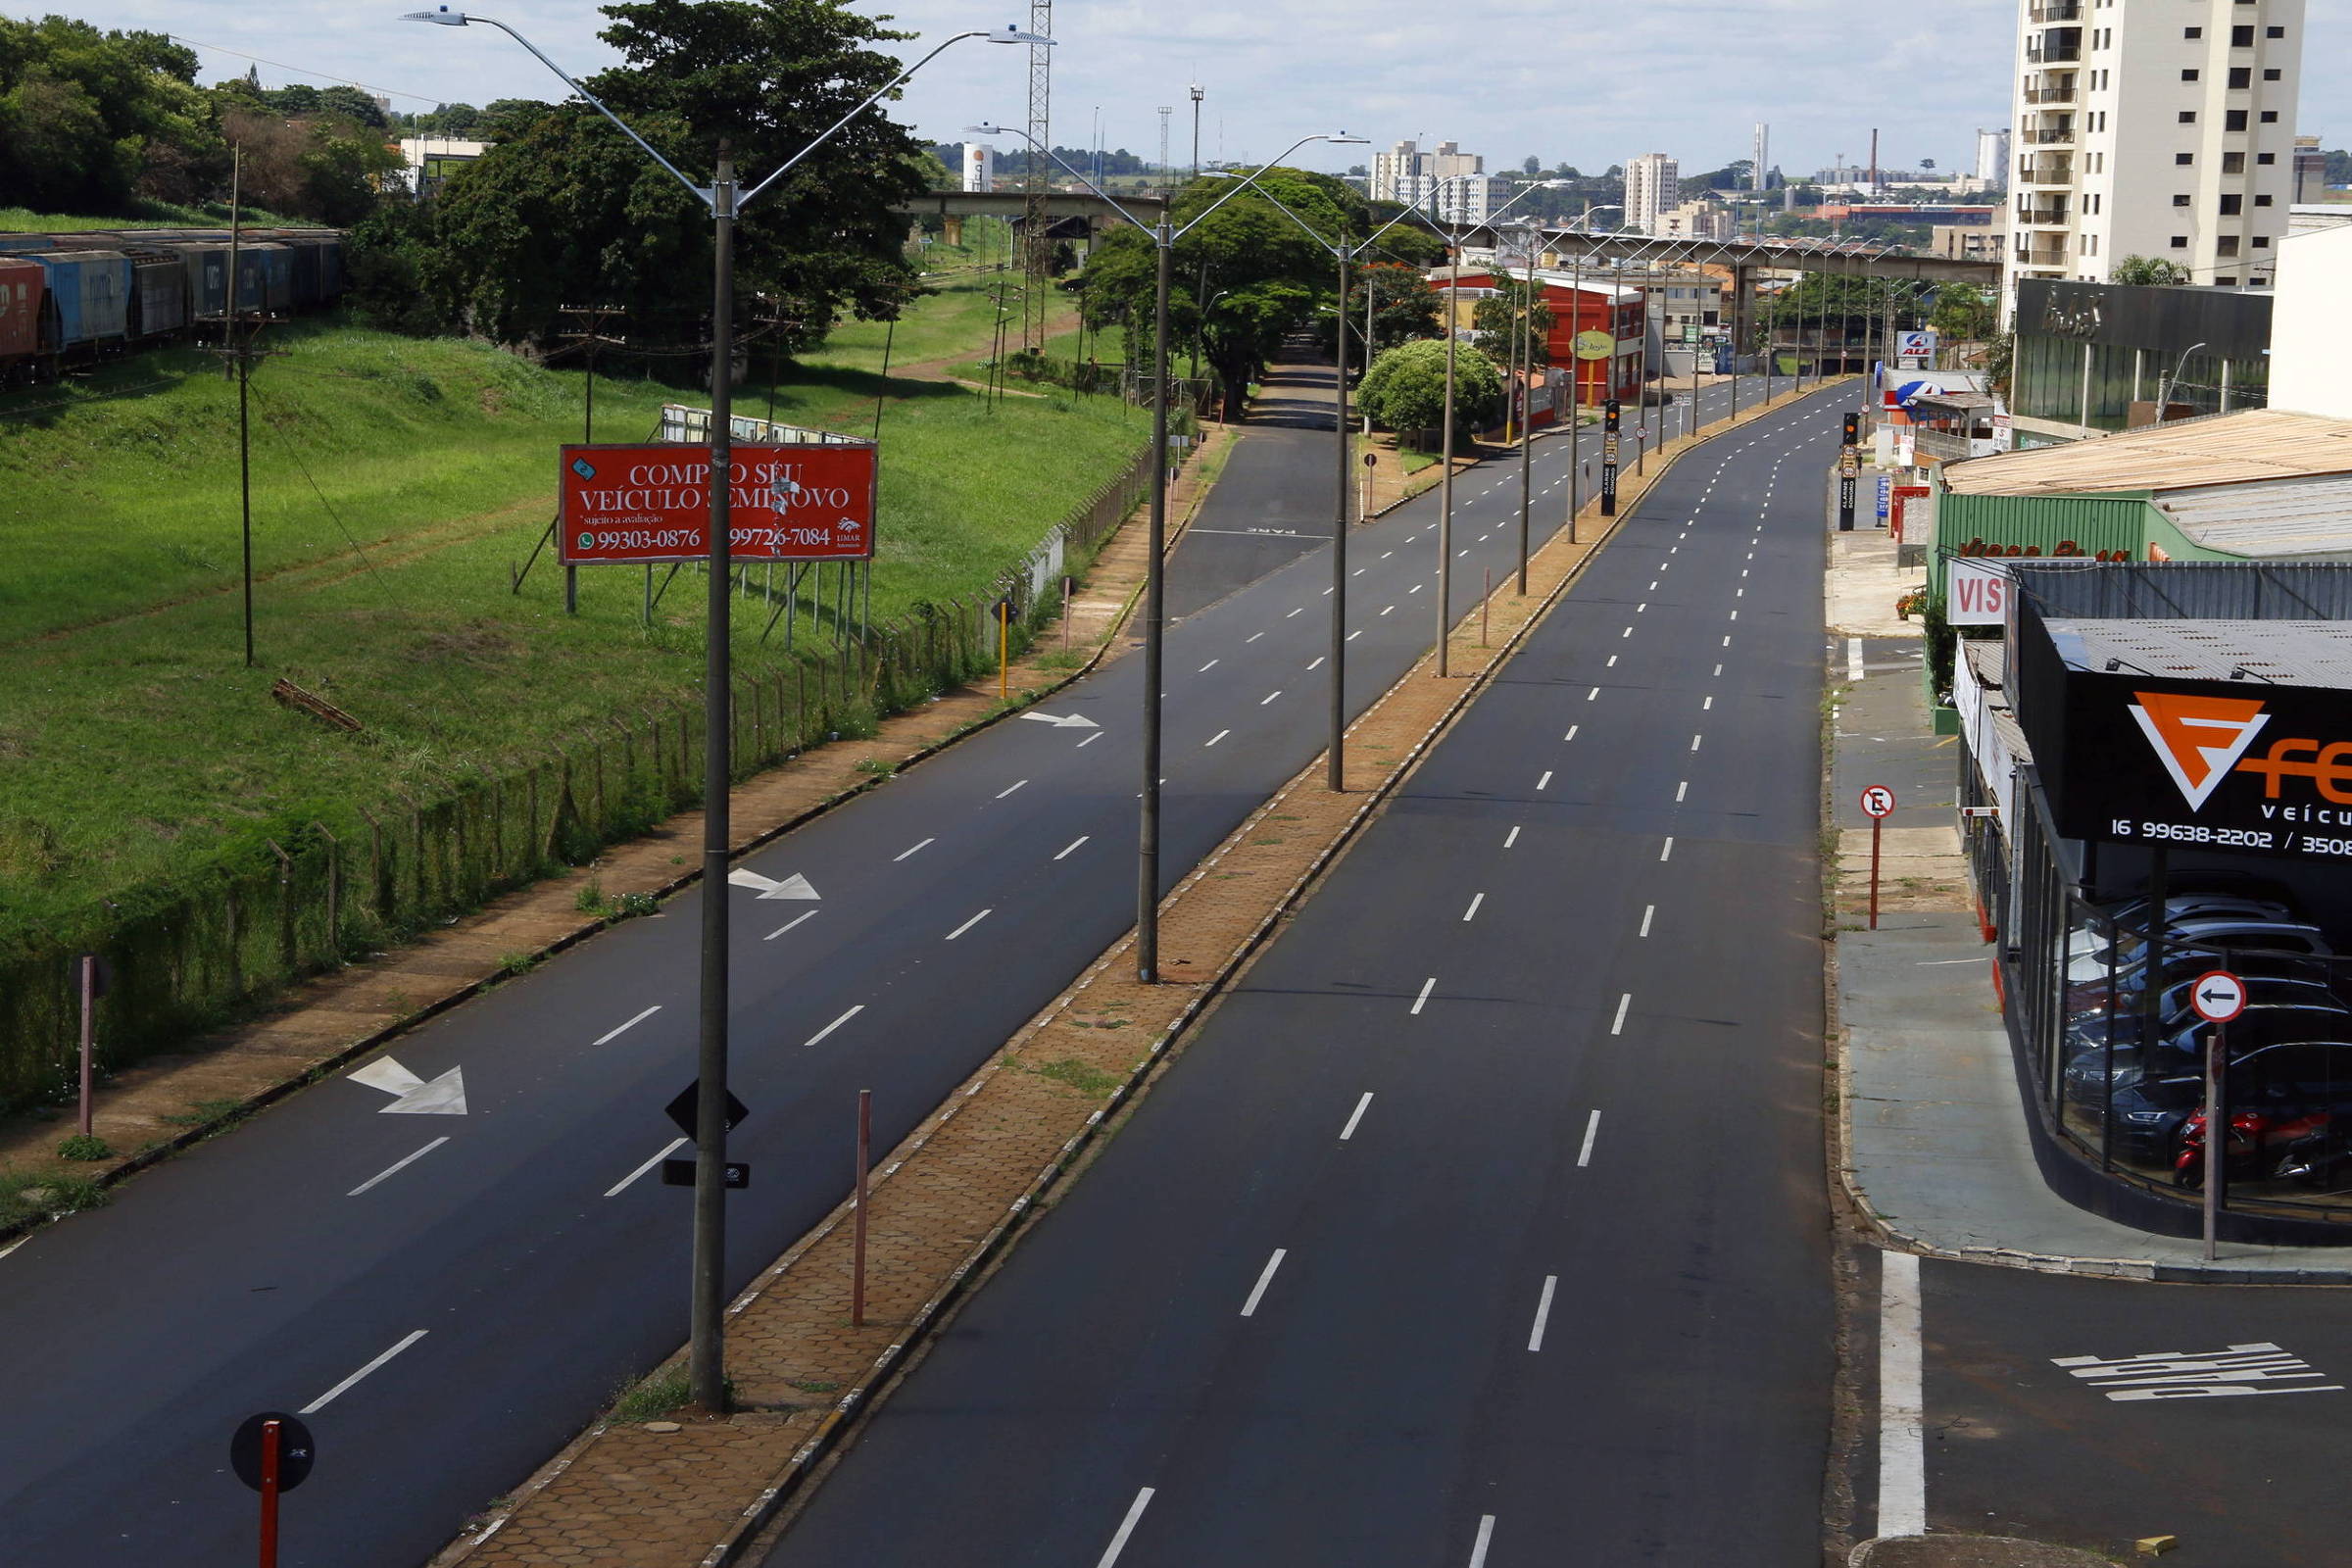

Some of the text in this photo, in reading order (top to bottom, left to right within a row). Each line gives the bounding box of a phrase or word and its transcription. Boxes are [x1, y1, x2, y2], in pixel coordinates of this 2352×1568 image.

[629, 462, 747, 486] COMPO
[580, 485, 701, 511] VEÍCULO
[598, 527, 831, 550] 99303-0876 99726-7084
[1958, 577, 2008, 612] VIS
[1872, 792, 1884, 810] E
[2112, 819, 2132, 835] 16
[2142, 822, 2273, 849] 99638-2202
[2049, 1342, 2345, 1401] PARE
